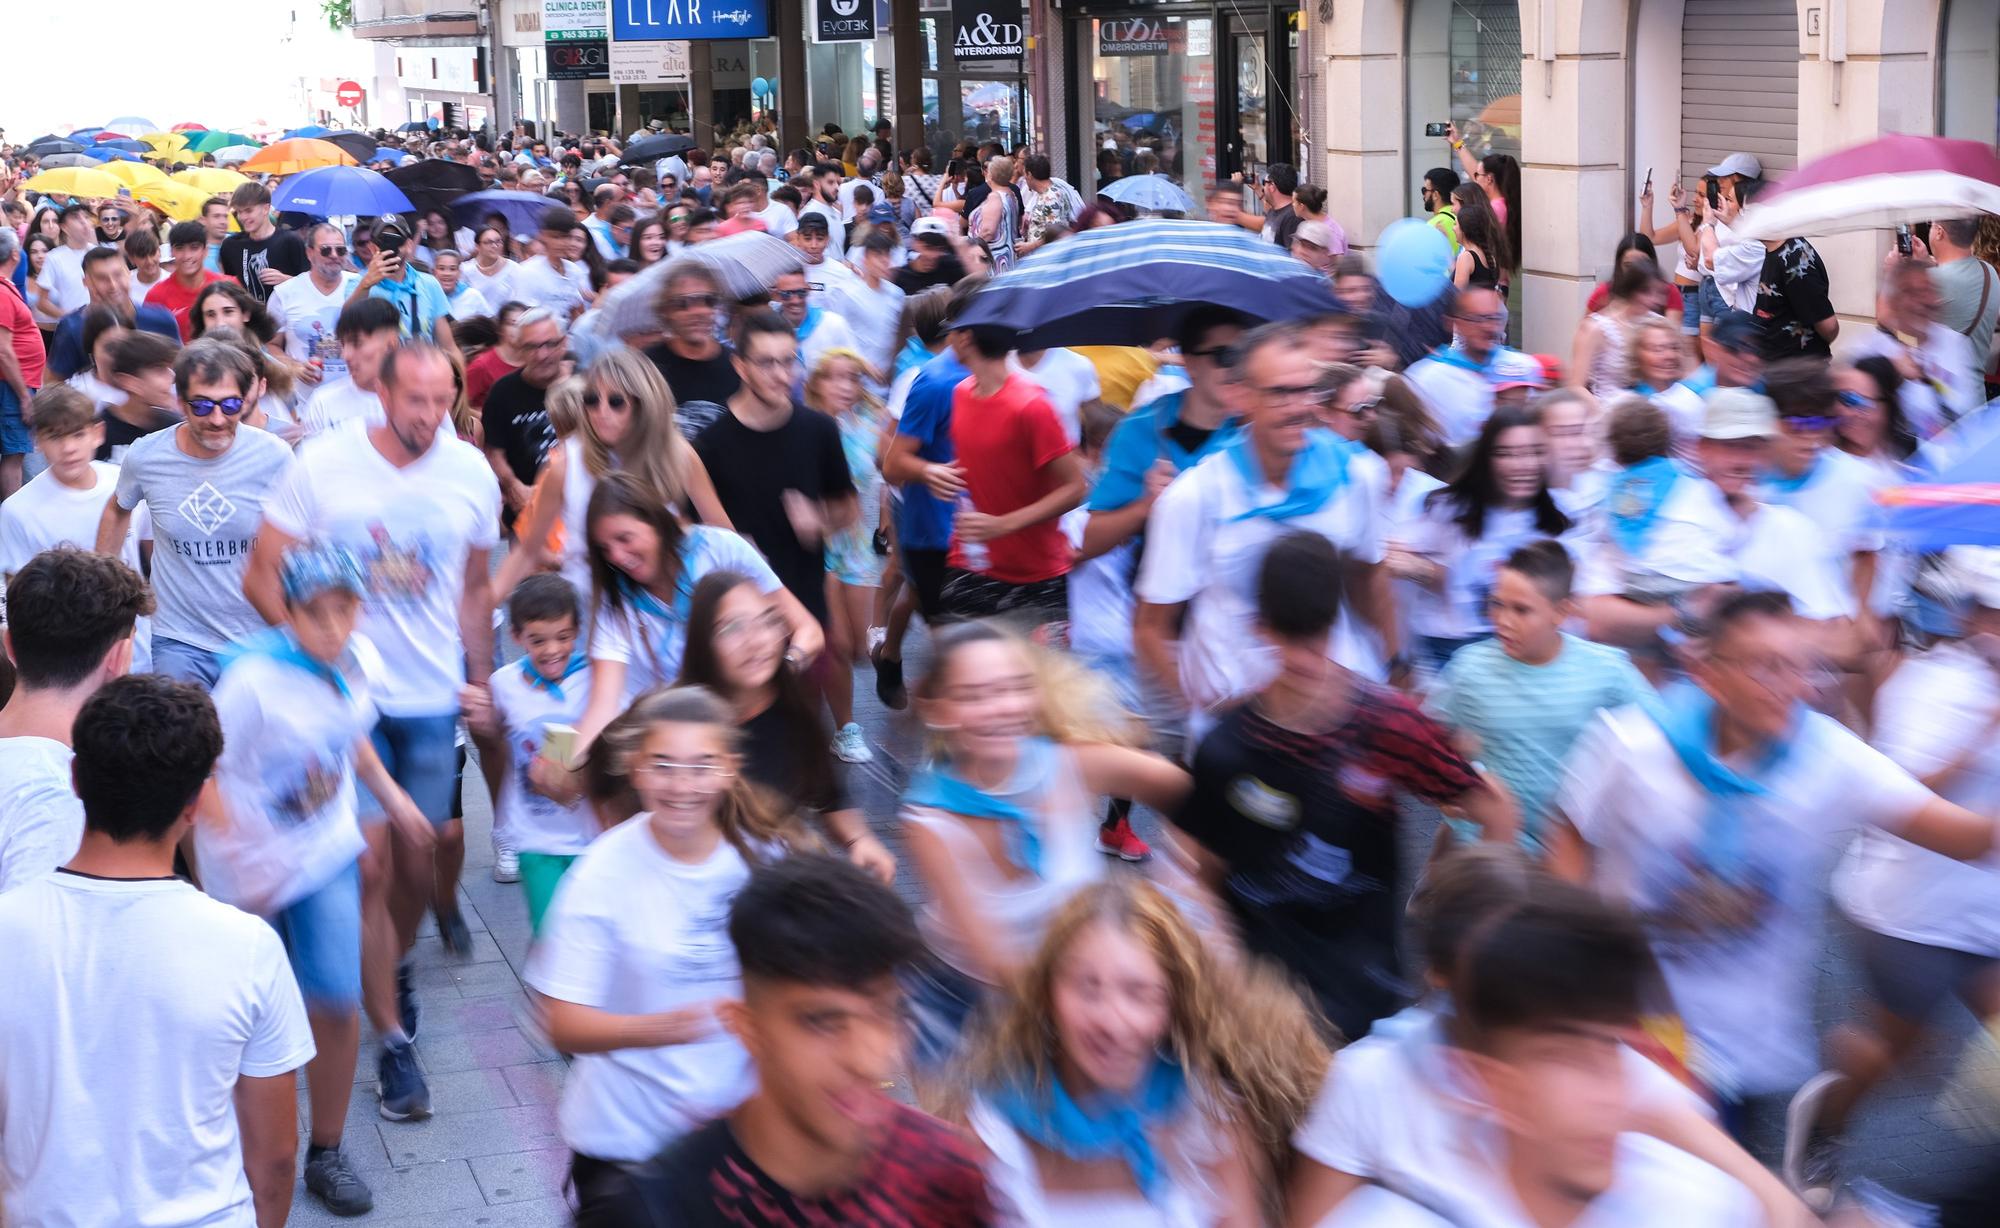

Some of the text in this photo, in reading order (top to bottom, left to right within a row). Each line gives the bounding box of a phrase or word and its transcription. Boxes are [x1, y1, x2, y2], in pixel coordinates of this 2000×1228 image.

[954, 13, 1022, 46] A&D
[1814, 14, 1819, 30] 5
[954, 46, 1023, 56] INTERIORISMO
